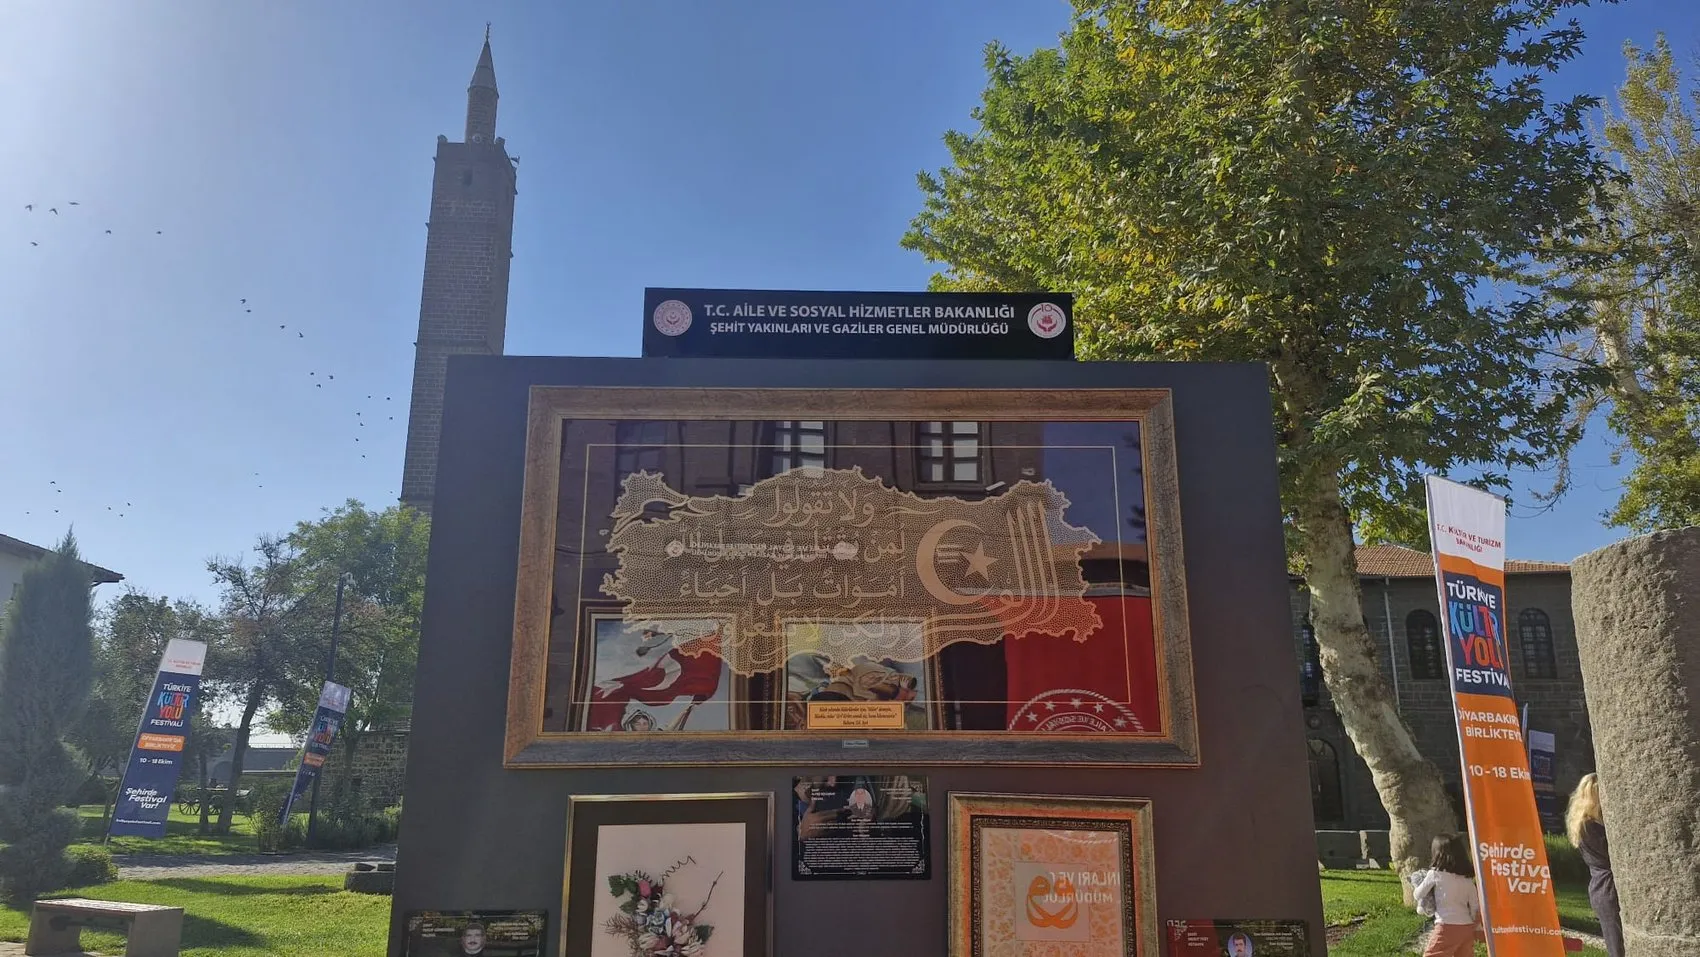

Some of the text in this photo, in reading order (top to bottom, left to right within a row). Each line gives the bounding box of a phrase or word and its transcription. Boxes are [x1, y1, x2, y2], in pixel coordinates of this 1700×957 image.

[704, 302, 1015, 319] T.C. AİLE VE SOSYAL HİZMETLER BAKANLIĞI
[710, 320, 1009, 335] ŞEHİT YAKINLARI VE GAZİLER GENEL MÜDÜRLÜĞÜ
[1468, 533, 1477, 542] VE
[1478, 536, 1502, 549] TURİZM
[1455, 667, 1510, 690] FESTİVA
[163, 682, 192, 693] TÜRKİYE
[150, 719, 184, 727] FESTİVALİ
[1469, 764, 1483, 776] 10
[1492, 766, 1507, 778] 18
[125, 787, 158, 796] Şehirde
[128, 794, 167, 804] Festival
[140, 801, 160, 809] Var!
[1479, 842, 1536, 861] Şehirde
[1491, 859, 1551, 879] Festiva
[1507, 877, 1548, 895] Var!
